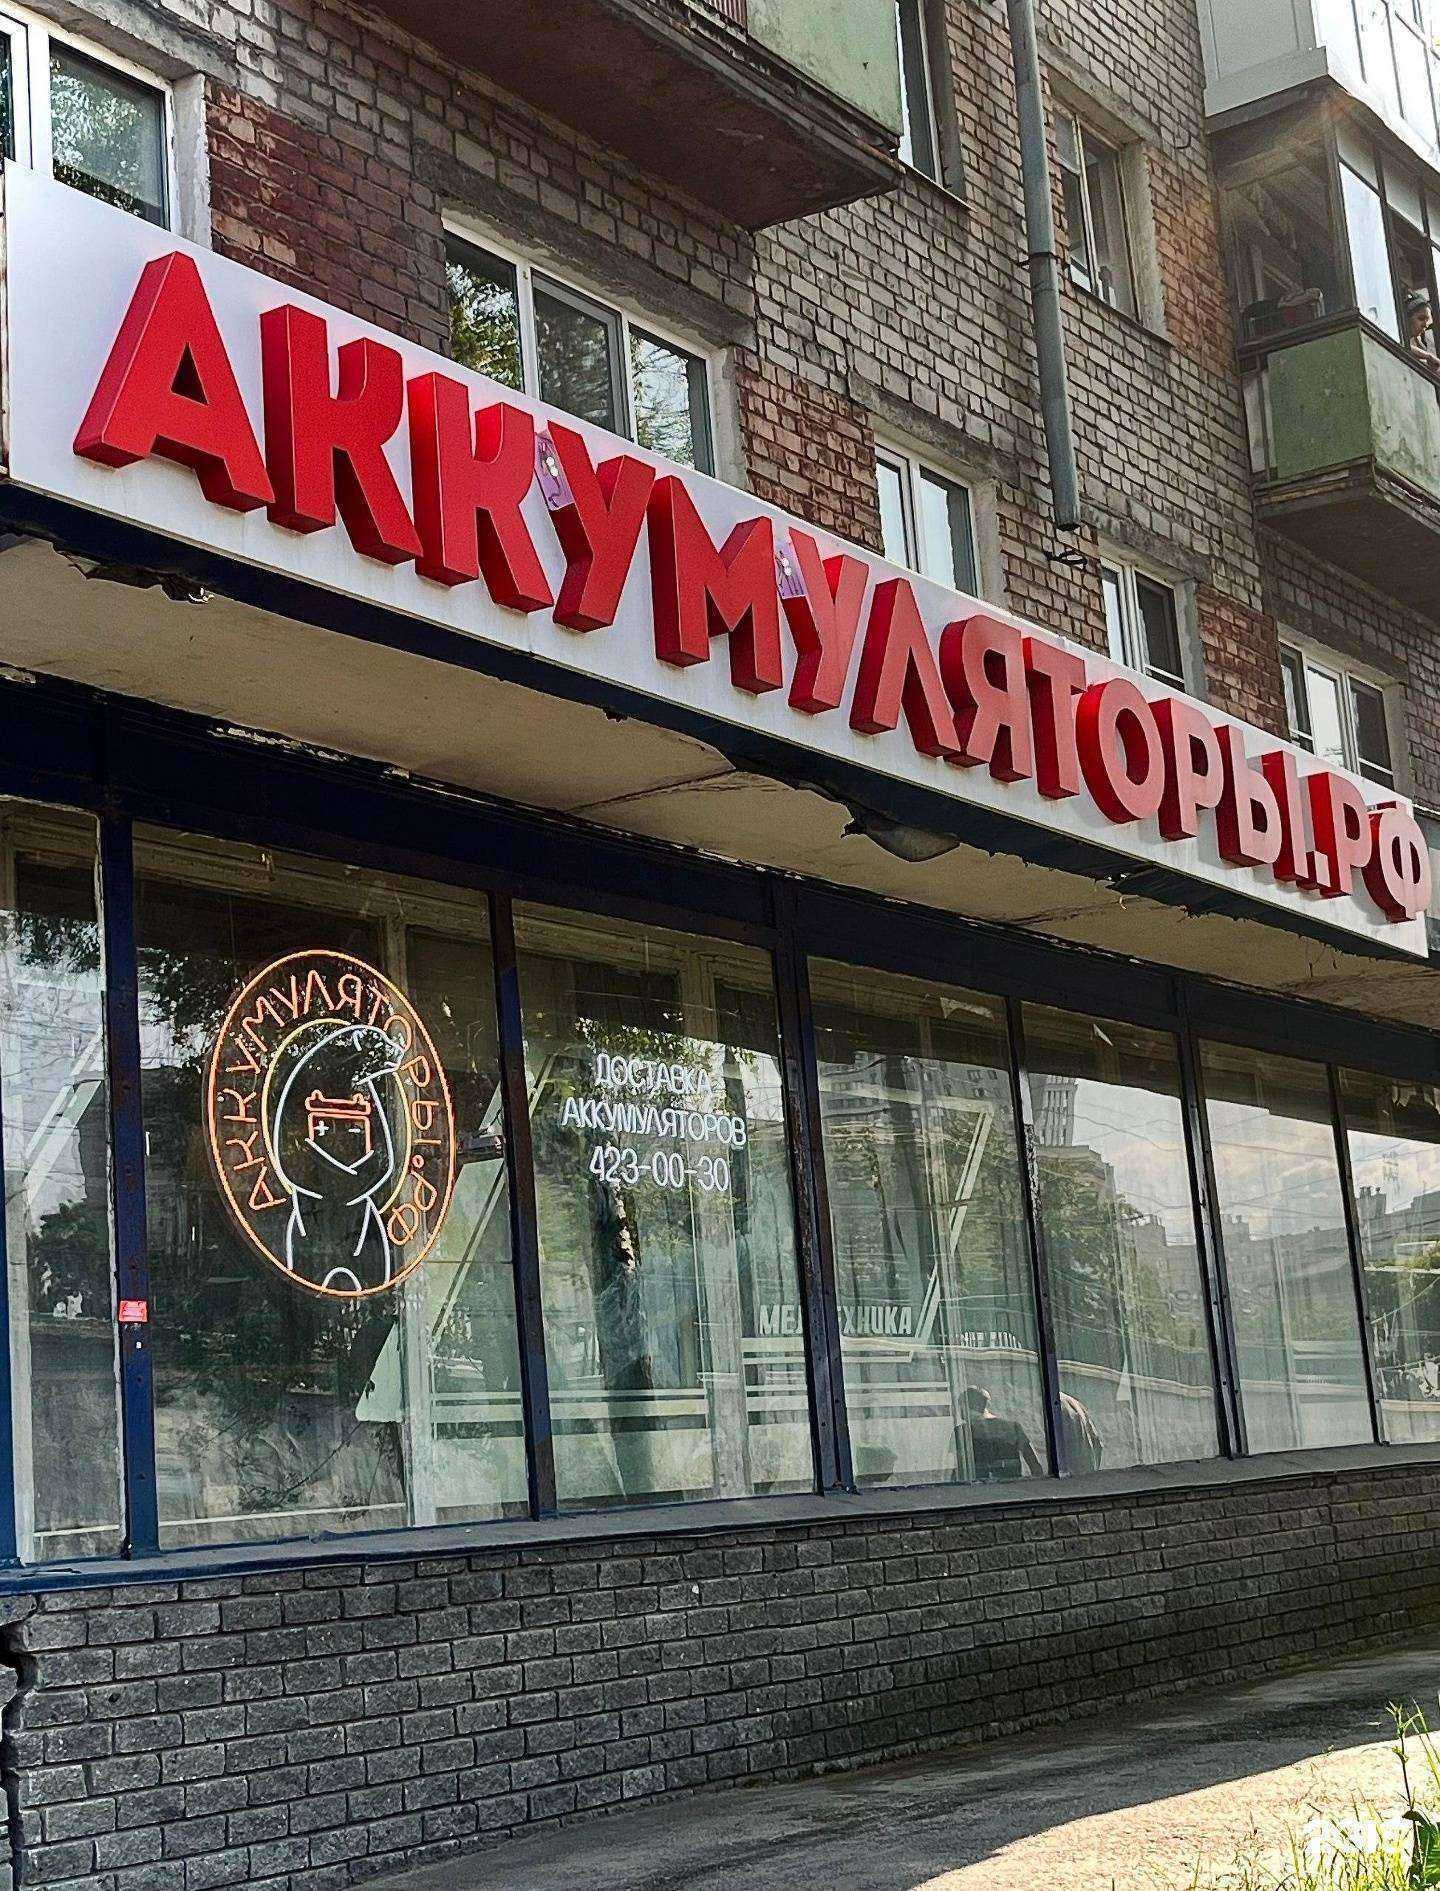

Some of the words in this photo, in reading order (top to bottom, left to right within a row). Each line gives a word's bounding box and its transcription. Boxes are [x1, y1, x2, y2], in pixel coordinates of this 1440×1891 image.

[74, 250, 1432, 923] АККУМУЛЯТОРЫ.РФ
[594, 1053, 713, 1096] ДОСТАВКА
[561, 1096, 747, 1146] АККУМУЛЯТОРОВ
[588, 1145, 730, 1192] 423-00-30
